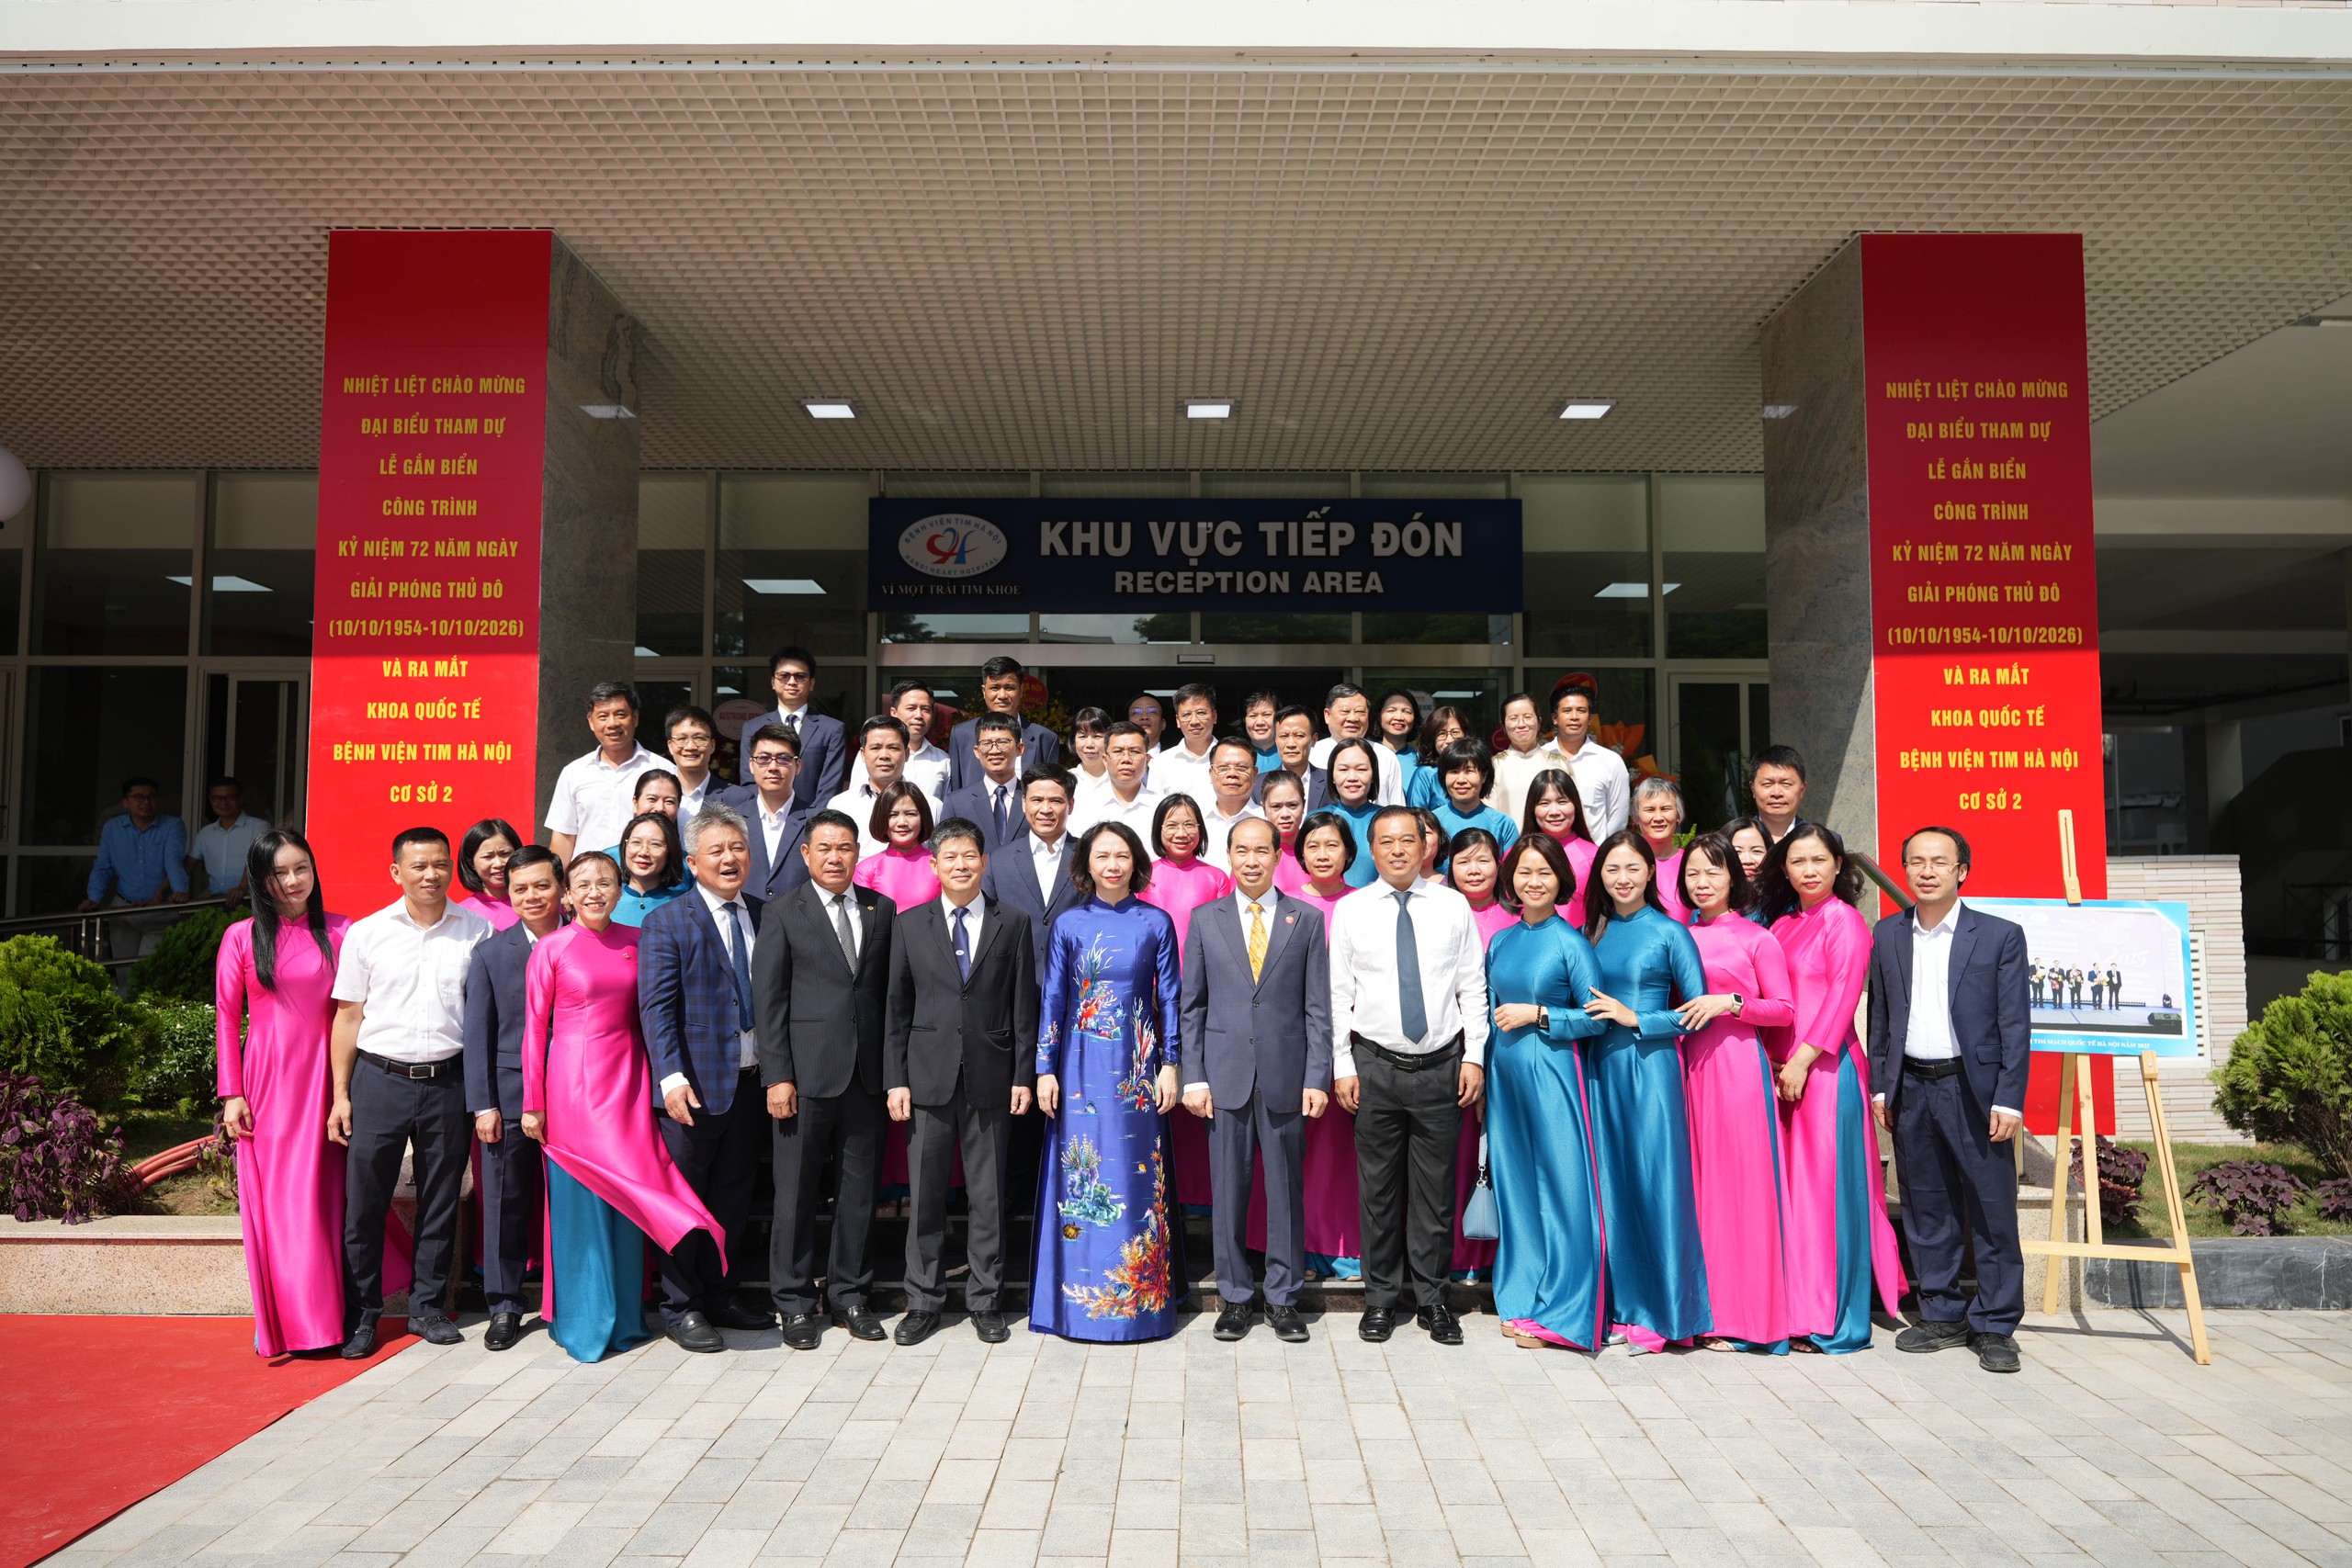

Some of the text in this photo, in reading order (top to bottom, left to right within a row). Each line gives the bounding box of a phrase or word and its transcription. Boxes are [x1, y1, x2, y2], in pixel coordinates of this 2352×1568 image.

[344, 375, 526, 397] NHIỆT LIỆT CHÀO MỪNG
[1886, 379, 2068, 401] NHIỆT LIỆT CHÀO MỪNG
[361, 412, 506, 437] ĐẠI BIỂU THAM DỰ
[1906, 417, 2051, 442] ĐẠI BIỂU THAM DỰ
[380, 453, 477, 475] LỄ GẮN BIỂN
[1928, 457, 2026, 479] LỄ GẮN BIỂN
[382, 497, 477, 515] CÔNG TRÌNH
[1934, 502, 2029, 520] CÔNG TRÌNH
[1041, 506, 1462, 566] KHU VỰC TIẾP ĐÓN
[338, 536, 518, 559] KỶ NIỆM 72 NĂM NGÀY
[1893, 540, 2072, 564] KỶ NIỆM 72 NĂM NGÀY
[351, 577, 503, 598] GIẢI PHÓNG THỦ ĐÔ
[960, 585, 982, 594] TIM
[1114, 571, 1384, 592] RECEPTION AREA
[1908, 581, 2060, 602] GIẢI PHÓNG THỦ ĐÔ
[329, 620, 524, 637] (10/10/1954-10/10/2026)
[1888, 627, 2083, 645] (10/10/1954-10/10/2026)
[382, 655, 468, 677] VÀ RA MẮT
[1944, 662, 2029, 684] VÀ RA MẮT
[368, 697, 481, 720] KHOA QUỐC TẾ
[1931, 705, 2044, 728] KHOA QUỐC TẾ
[334, 741, 512, 764] BỆNH VIỆN TIM HÀ NỘI
[1900, 748, 2078, 772] BỆNH VIỆN TIM HÀ NỘI
[390, 781, 452, 802] CƠ SỞ 2
[1960, 788, 2021, 809] CƠ SỞ 2
